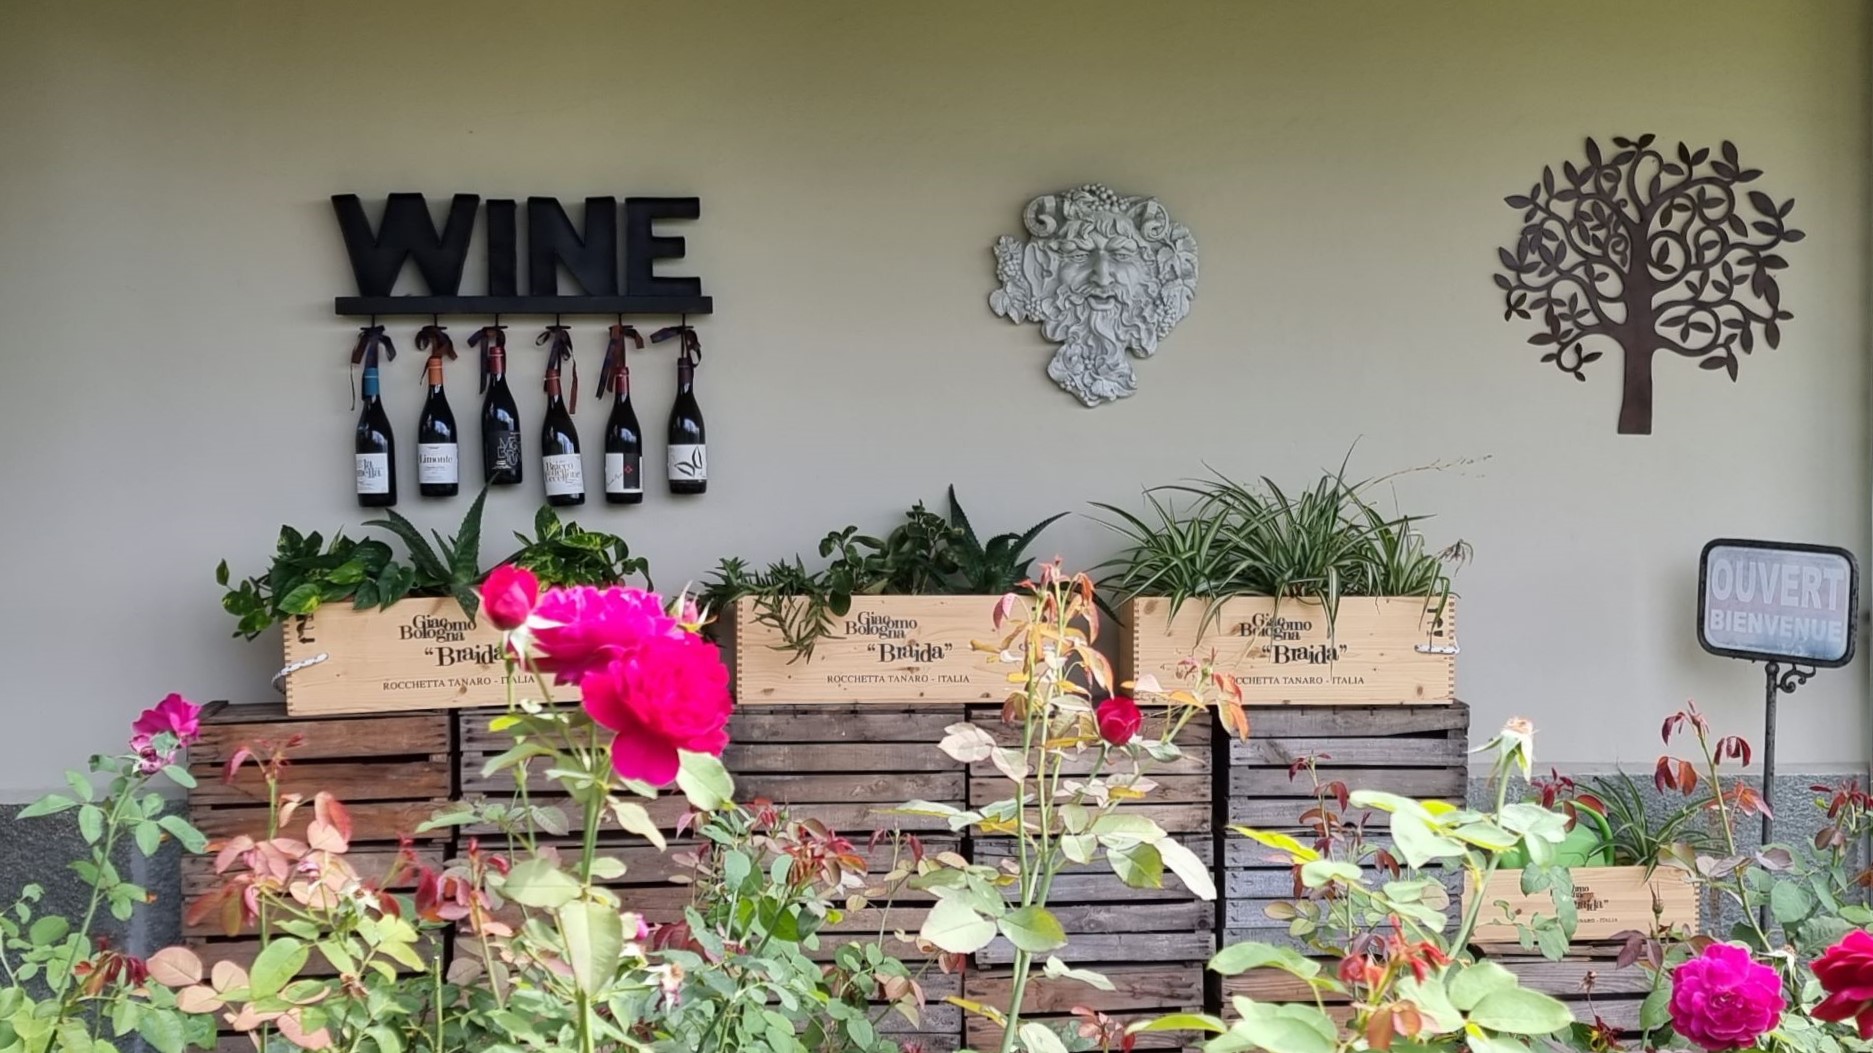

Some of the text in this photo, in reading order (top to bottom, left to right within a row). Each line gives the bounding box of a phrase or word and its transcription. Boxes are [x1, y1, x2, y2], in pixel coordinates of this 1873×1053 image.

[331, 193, 701, 297] WINE
[1711, 558, 1844, 611] OUVERT
[412, 615, 477, 631] Giacomo
[845, 620, 906, 639] Bologna
[857, 611, 918, 629] Giacomo
[1710, 609, 1843, 643] BIENVENUE
[399, 624, 465, 643] Bologna
[867, 643, 953, 663] “Braida”
[1262, 644, 1348, 664] “Braida”
[383, 679, 446, 690] ROCCHETTA
[448, 677, 492, 687] TANARO
[827, 675, 886, 683] ROCCHETTA
[888, 675, 929, 683] TANARO
[937, 675, 970, 683] ITALIA
[1235, 676, 1280, 685] CCHETTA
[1282, 676, 1323, 684] TANARO
[1332, 676, 1365, 685] ITALIA
